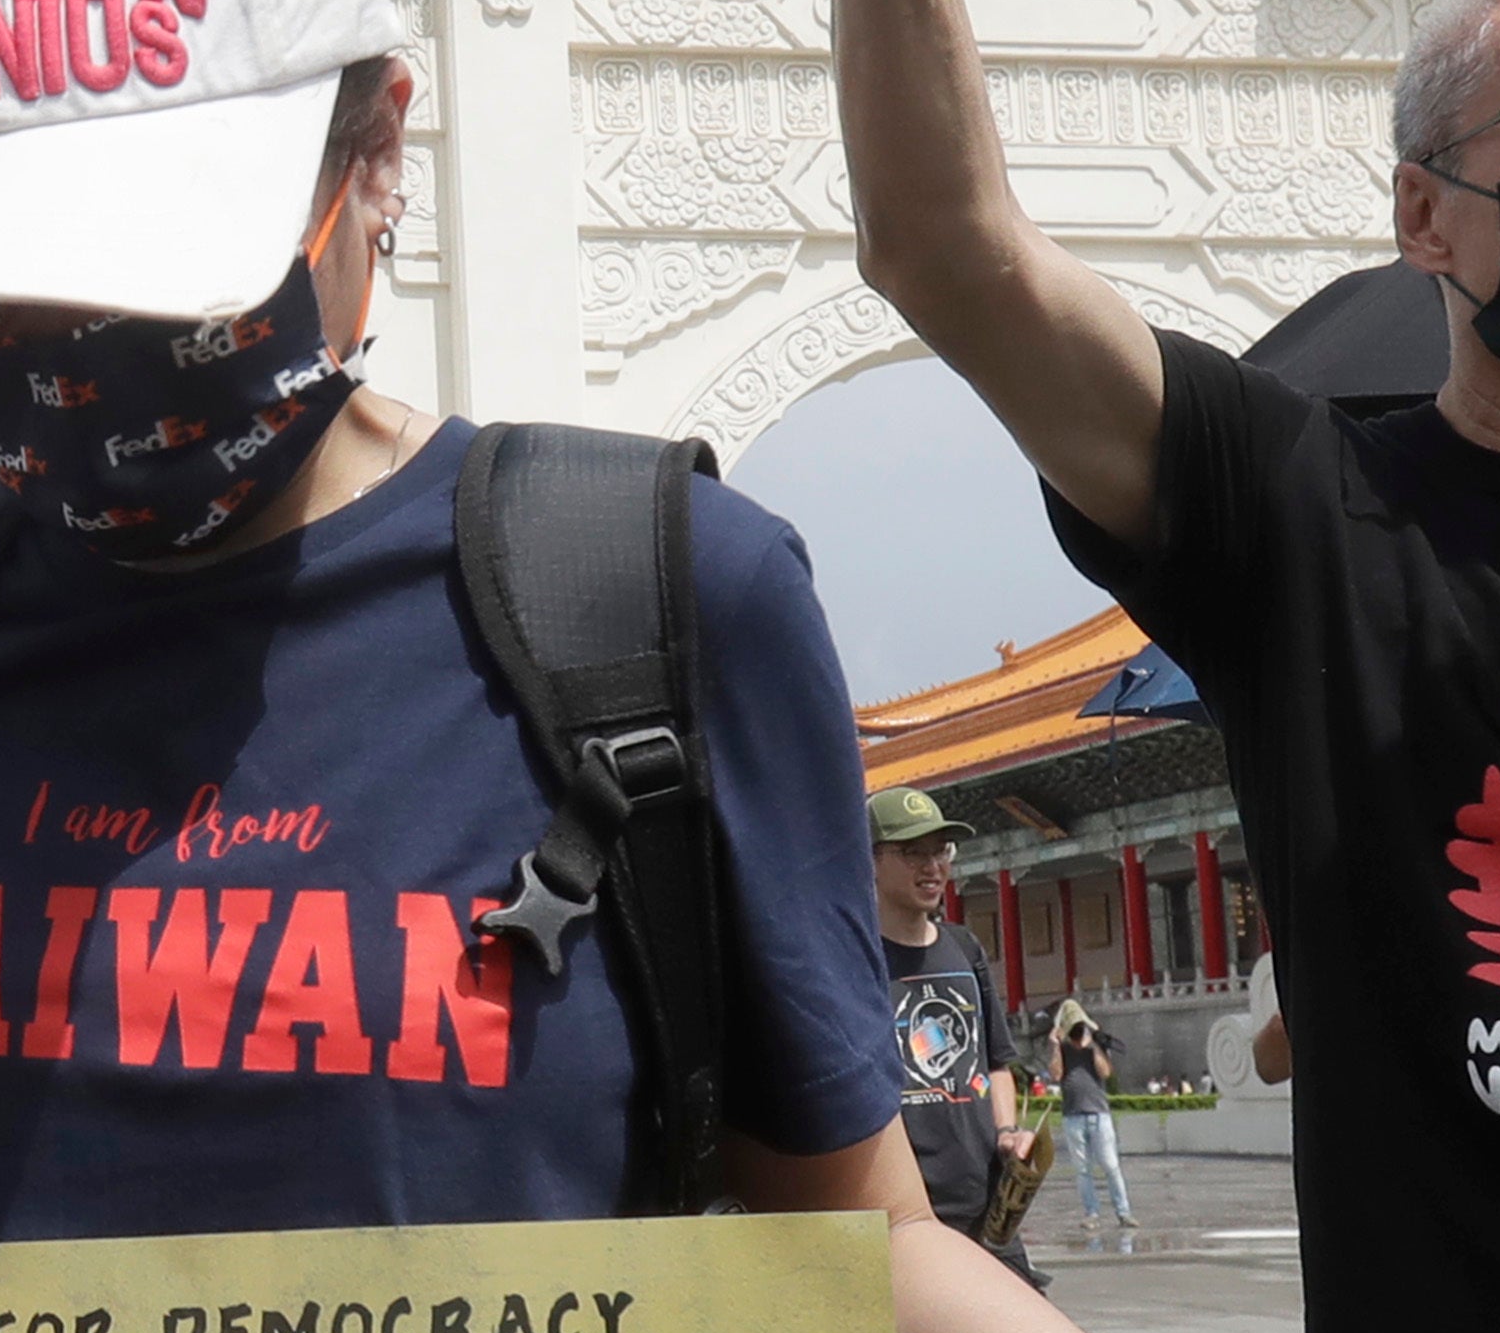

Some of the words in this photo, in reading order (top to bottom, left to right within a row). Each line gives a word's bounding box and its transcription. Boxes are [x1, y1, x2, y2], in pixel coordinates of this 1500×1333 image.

[169, 313, 275, 370] FedEx
[27, 372, 101, 409] FedEx
[105, 415, 210, 468] FedEx
[212, 395, 308, 474] FedEx
[62, 502, 157, 532] FedEx
[24, 781, 50, 844] I
[65, 808, 160, 852] am
[175, 782, 331, 861] from
